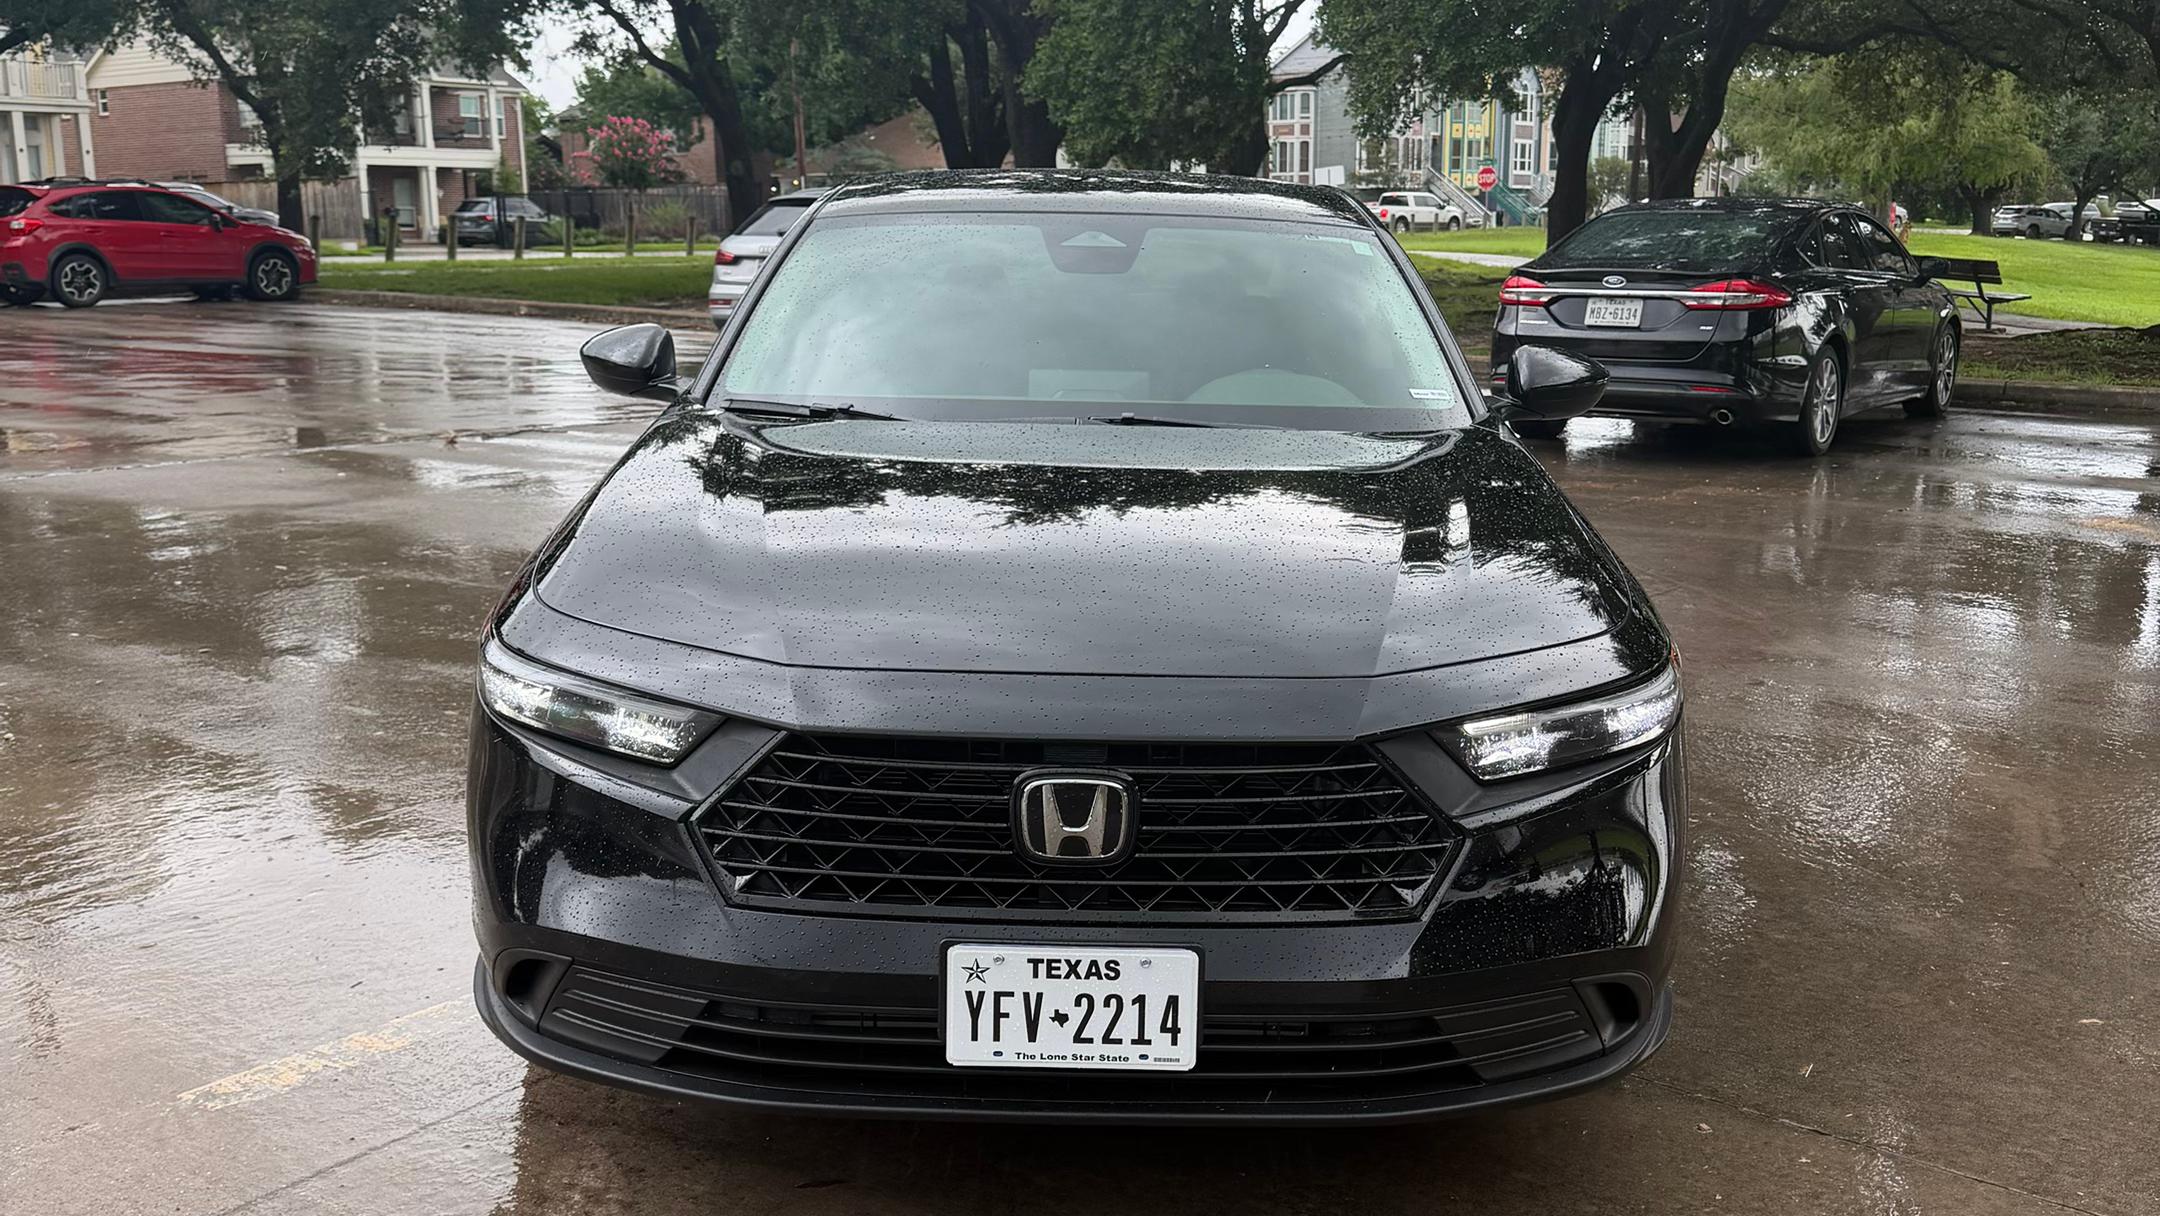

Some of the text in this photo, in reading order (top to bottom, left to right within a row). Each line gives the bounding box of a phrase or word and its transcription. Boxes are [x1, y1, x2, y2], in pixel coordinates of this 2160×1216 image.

[1478, 174, 1496, 183] STOP
[1612, 307, 1638, 320] 6134
[1027, 958, 1121, 981] TEXAS
[965, 991, 1182, 1047] YFV 2214
[1015, 1052, 1130, 1063] The Lone Star State
